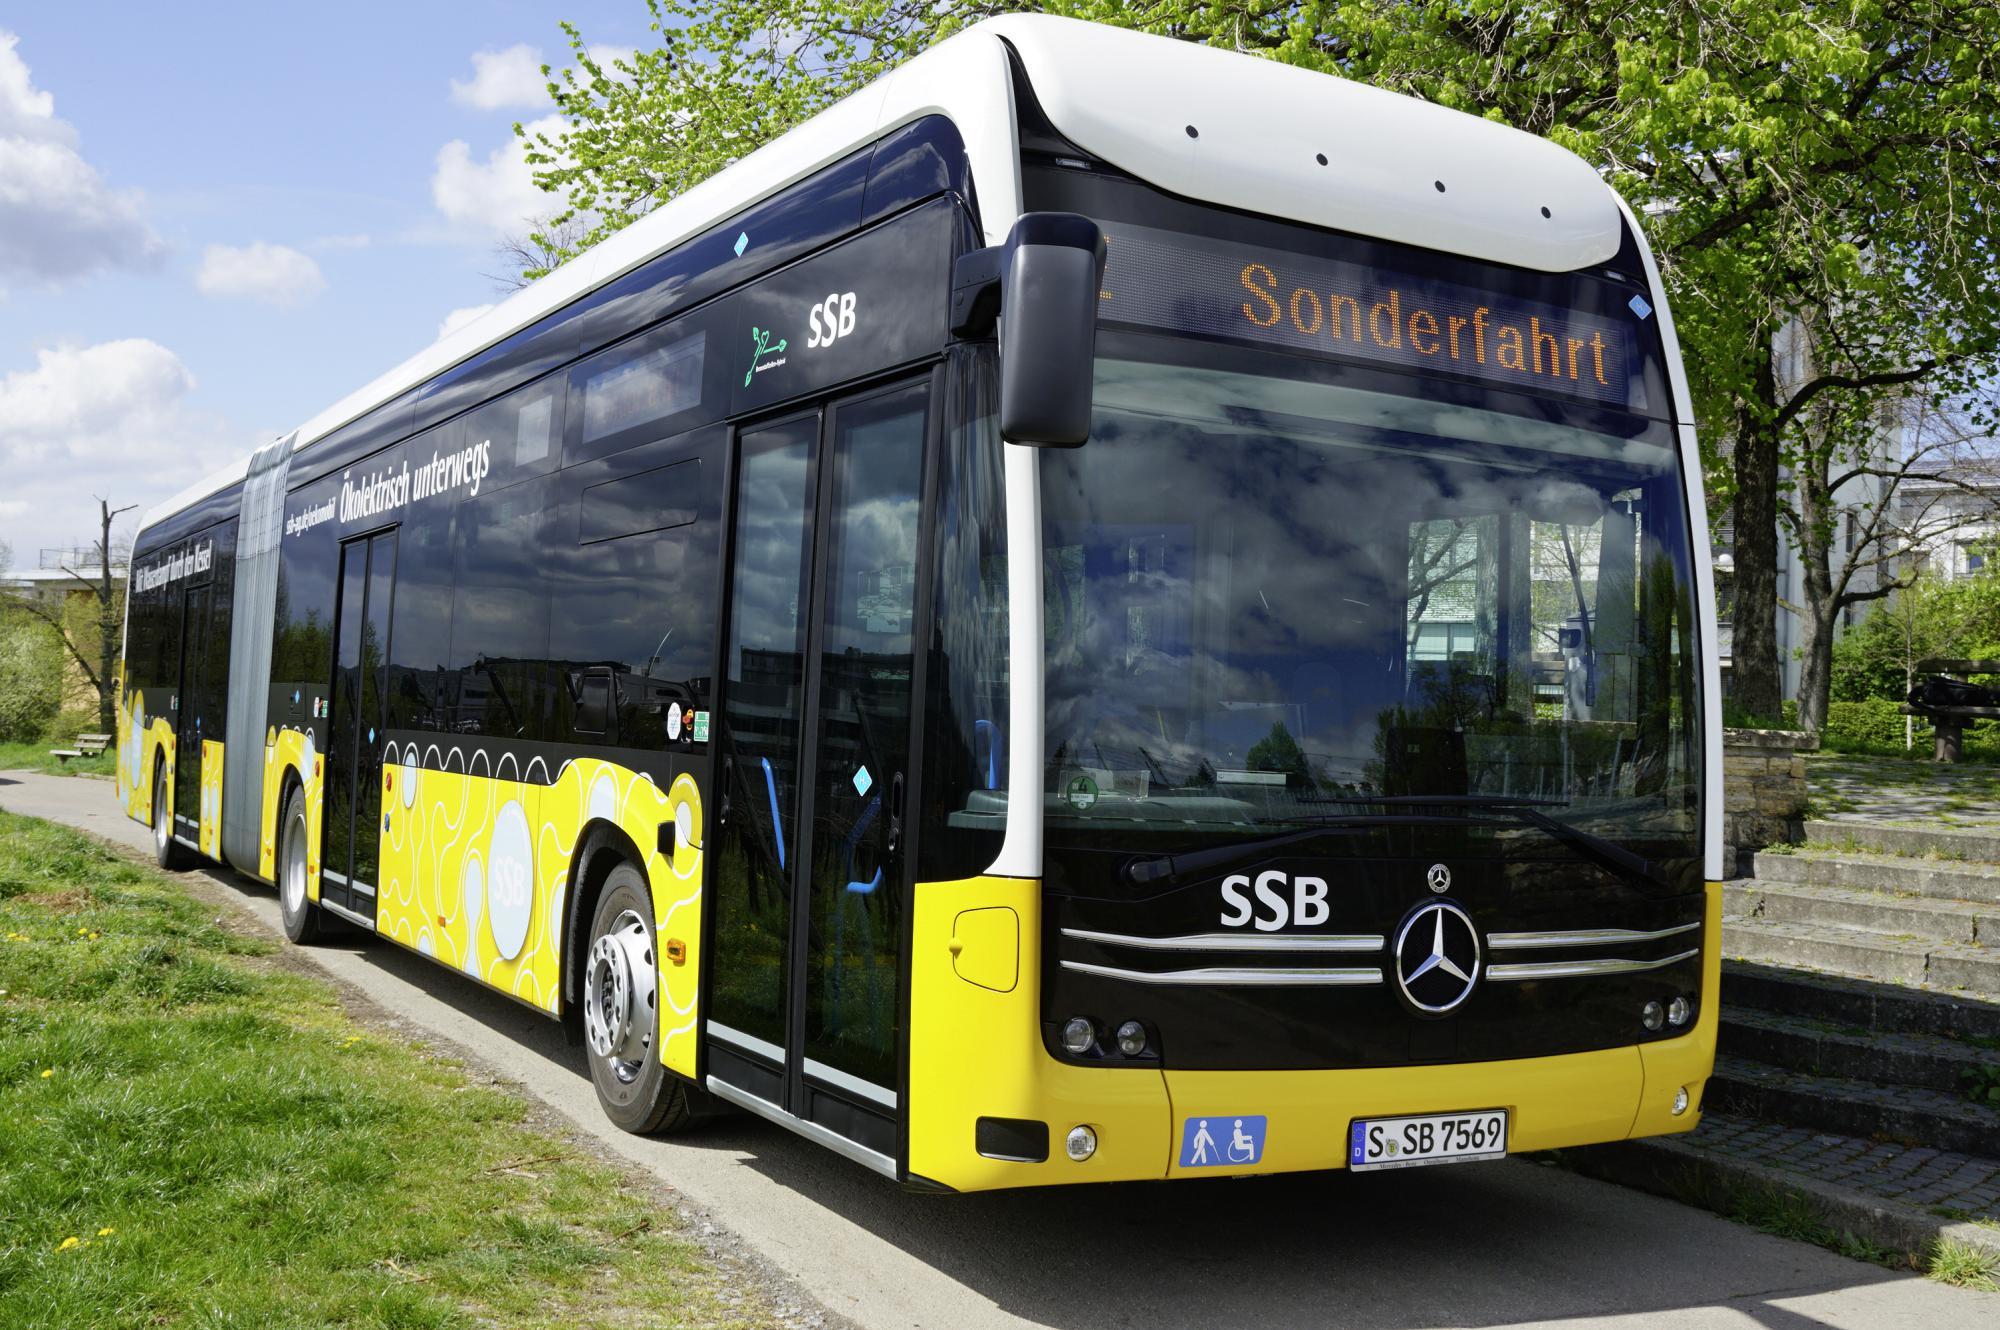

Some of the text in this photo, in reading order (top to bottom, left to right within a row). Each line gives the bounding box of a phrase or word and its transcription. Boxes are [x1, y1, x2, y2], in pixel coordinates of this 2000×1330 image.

[807, 292, 856, 348] SSB
[1241, 263, 1608, 385] Sonderfahrt
[340, 440, 490, 523] Ökolektrisch unterwegs
[495, 855, 525, 907] SSB
[1221, 870, 1330, 931] SSB
[1354, 1147, 1361, 1157] D
[1368, 1117, 1501, 1158] S SB 7569
